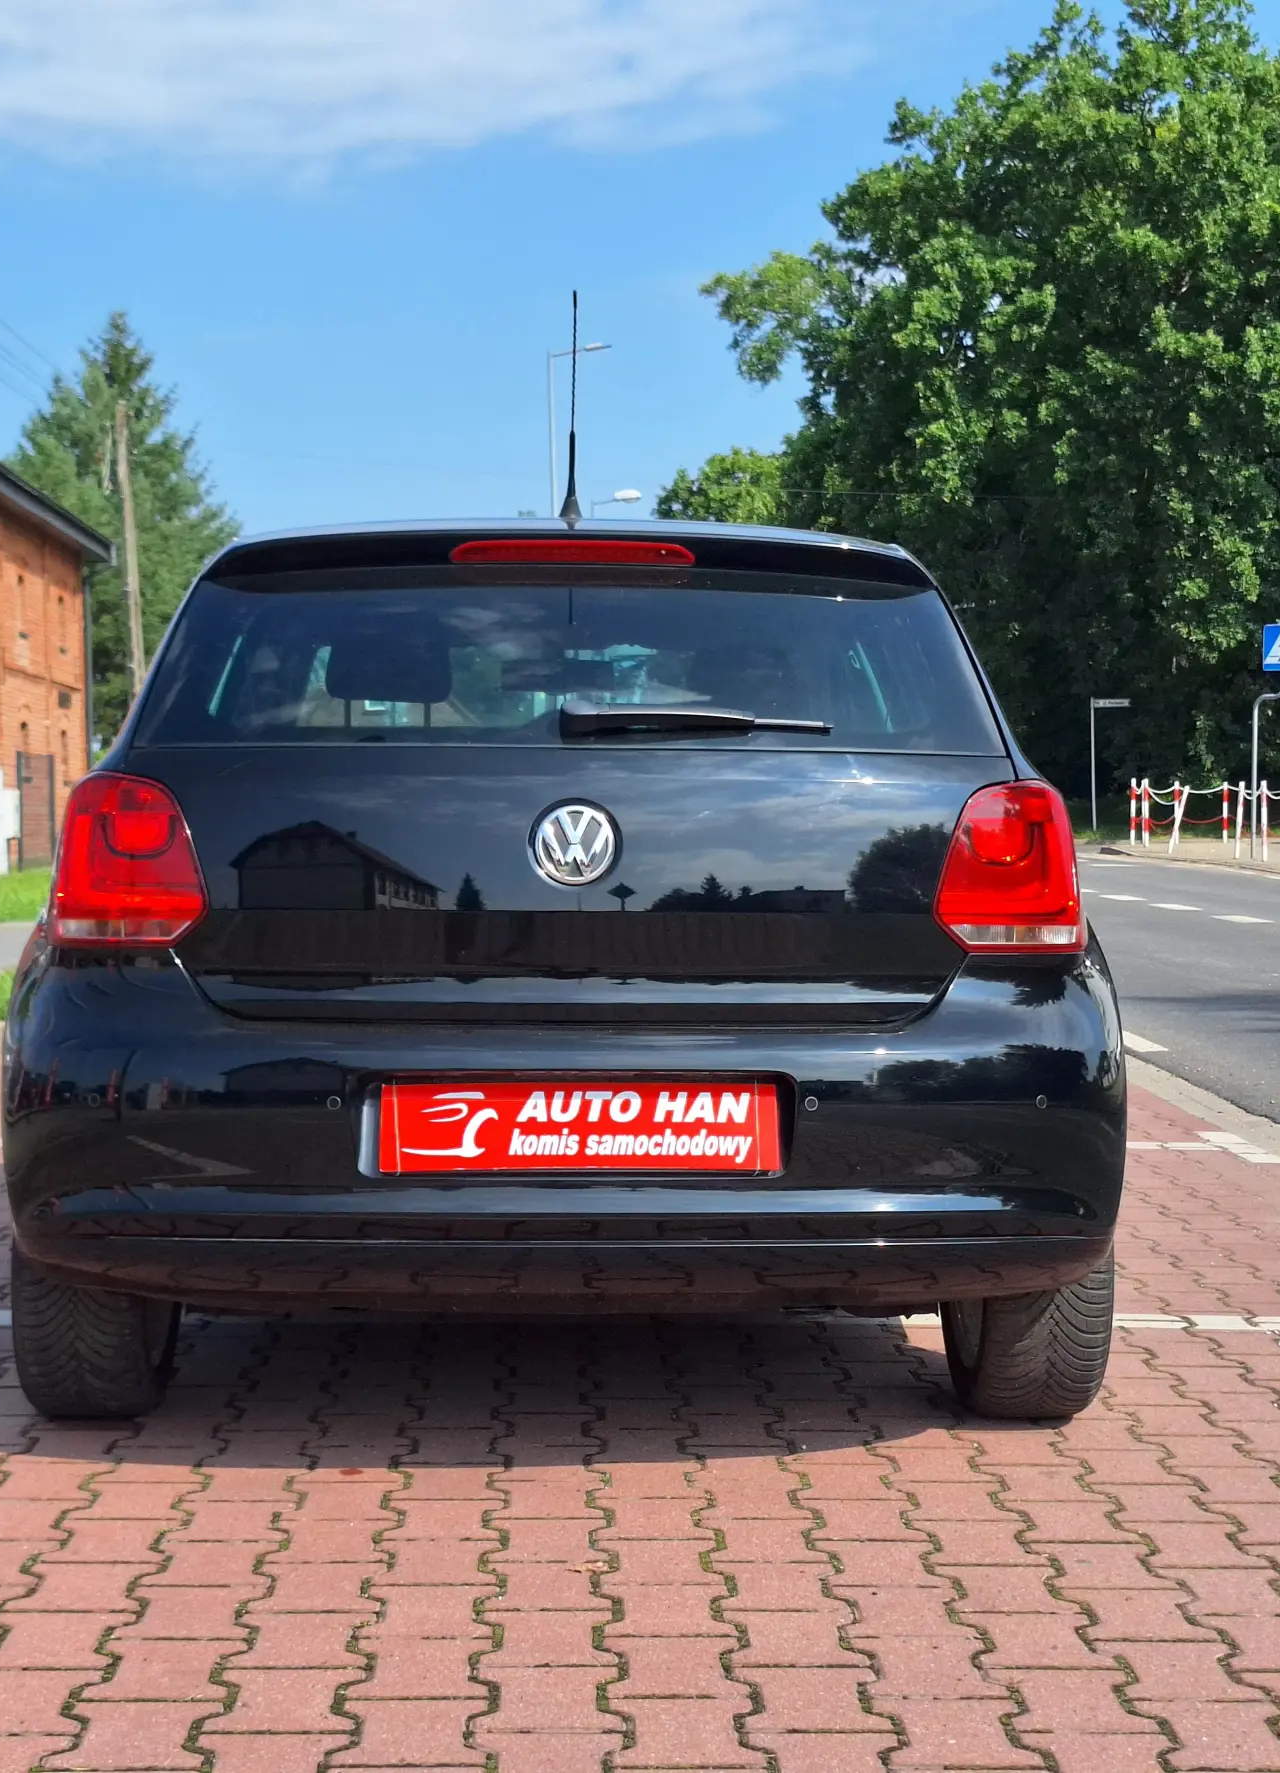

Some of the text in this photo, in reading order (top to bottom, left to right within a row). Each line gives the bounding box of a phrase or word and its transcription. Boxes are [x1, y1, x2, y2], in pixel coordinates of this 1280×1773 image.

[516, 1091, 751, 1124] AUTO HAN
[508, 1128, 753, 1164] komis samochodowy
